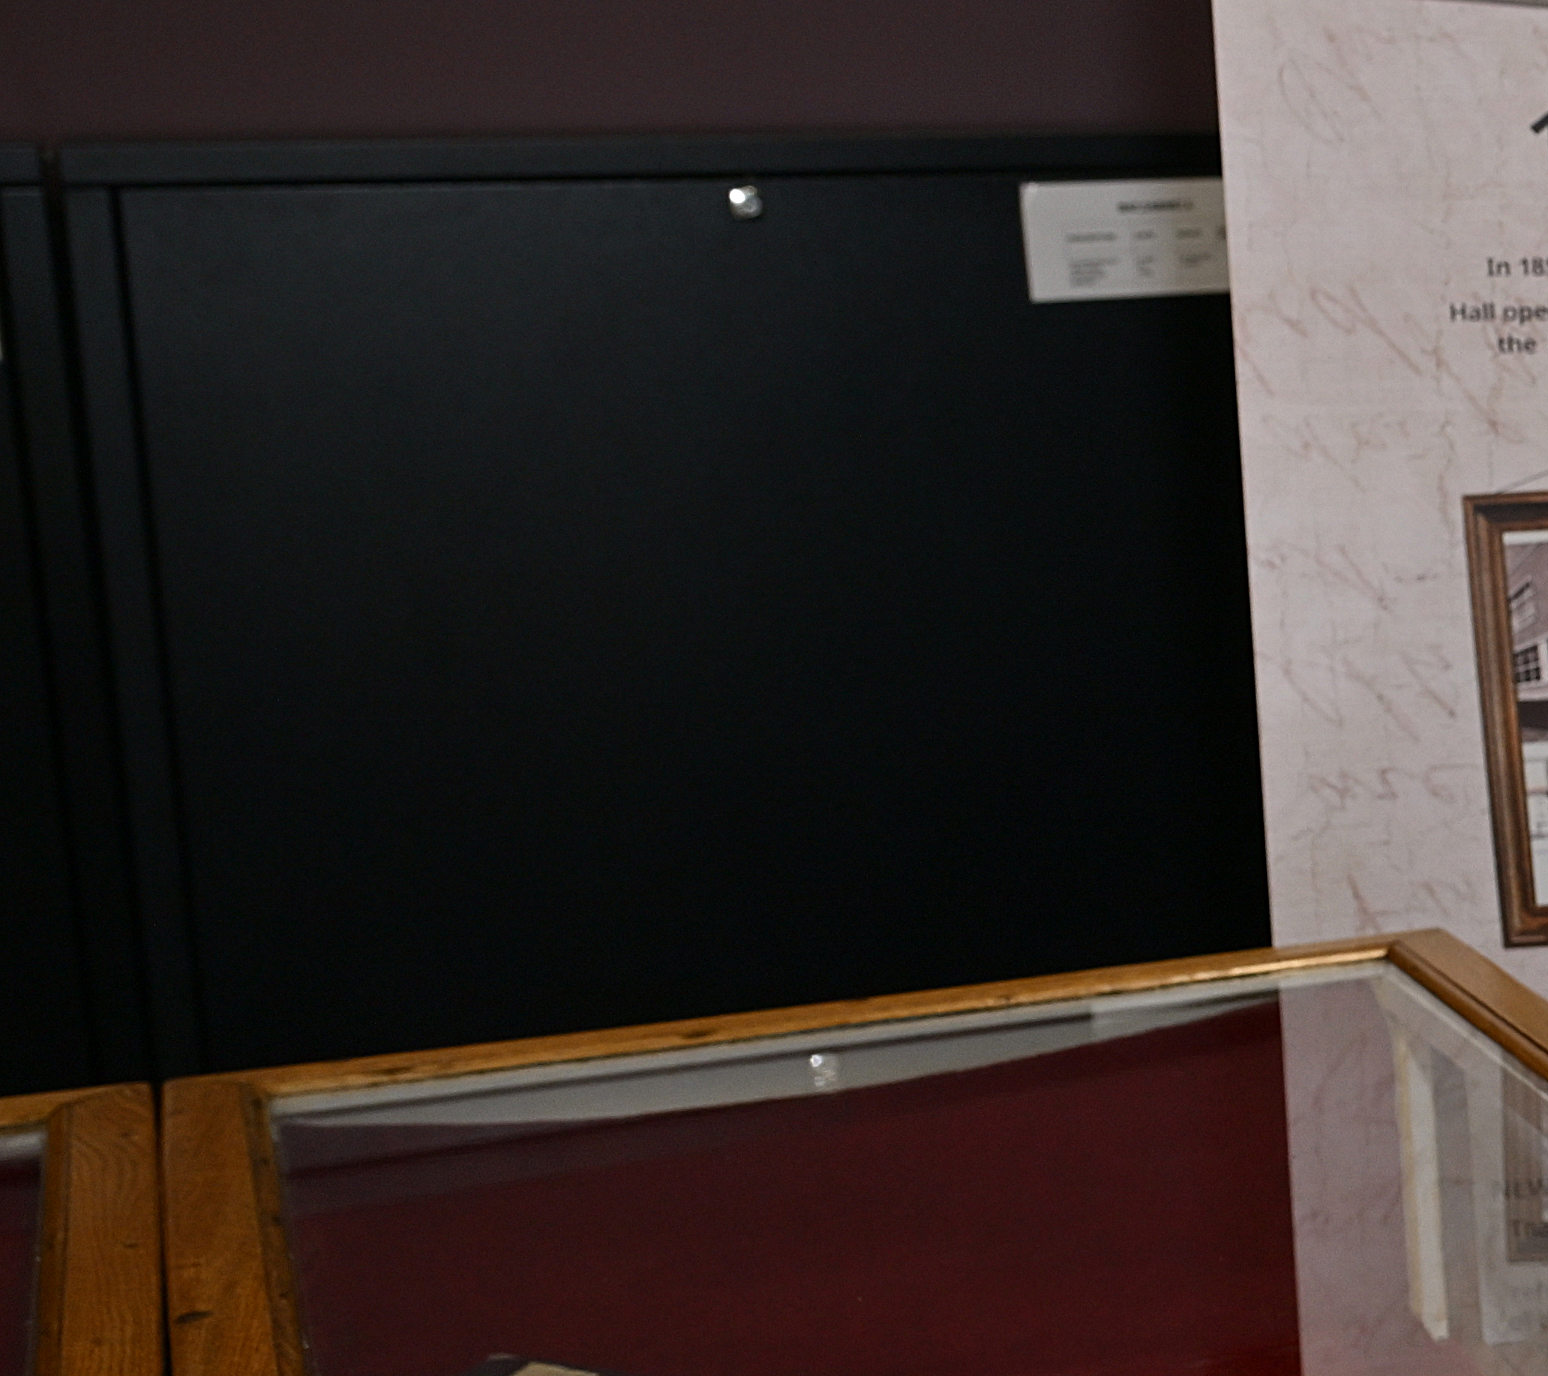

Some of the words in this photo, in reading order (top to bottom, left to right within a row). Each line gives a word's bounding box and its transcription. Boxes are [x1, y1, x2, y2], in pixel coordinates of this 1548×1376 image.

[1486, 257, 1511, 277] In
[1449, 302, 1495, 323] Hall
[1497, 335, 1537, 355] the
